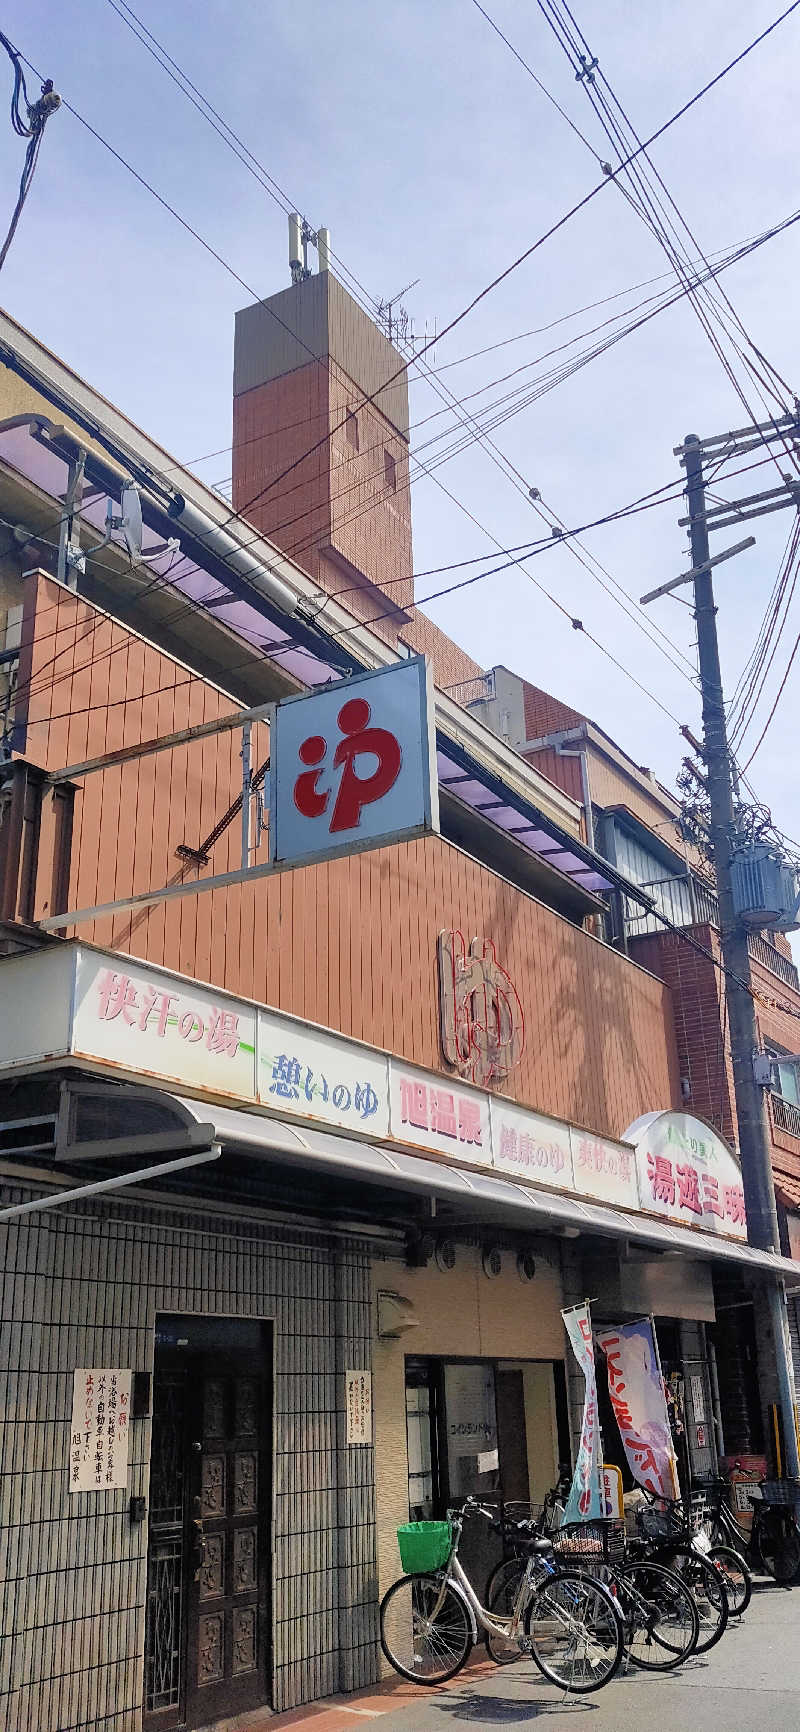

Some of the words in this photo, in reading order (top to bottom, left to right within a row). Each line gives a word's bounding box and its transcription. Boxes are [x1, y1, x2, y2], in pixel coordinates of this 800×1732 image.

[98, 969, 241, 1058] 快汗の湯
[269, 1054, 379, 1119] 憩いのゆ
[400, 1080, 482, 1147] 旭温泉
